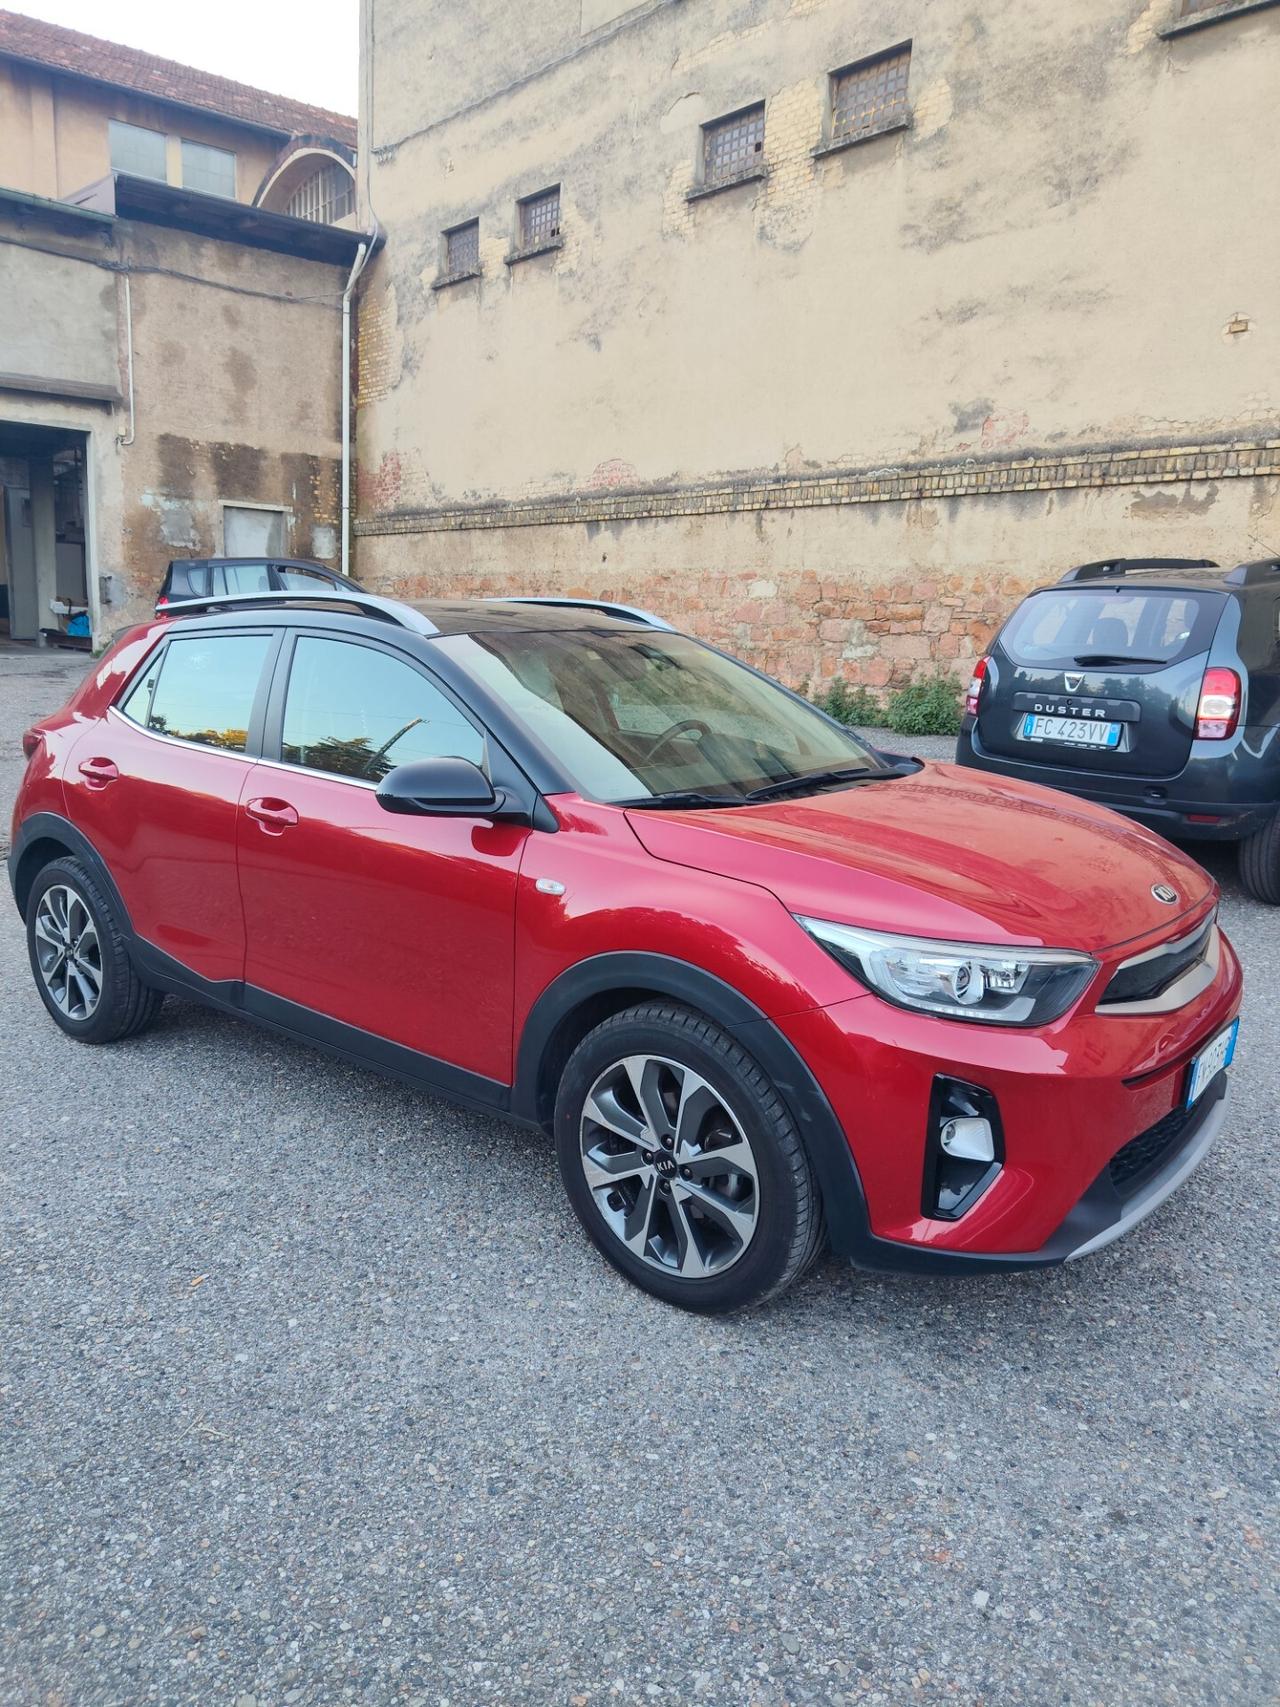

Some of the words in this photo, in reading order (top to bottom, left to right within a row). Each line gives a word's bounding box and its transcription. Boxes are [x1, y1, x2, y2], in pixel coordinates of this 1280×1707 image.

[1034, 703, 1106, 717] DUSTER
[1034, 718, 1054, 736] FC
[1057, 720, 1108, 740] 423VV
[656, 1160, 675, 1171] KIA
